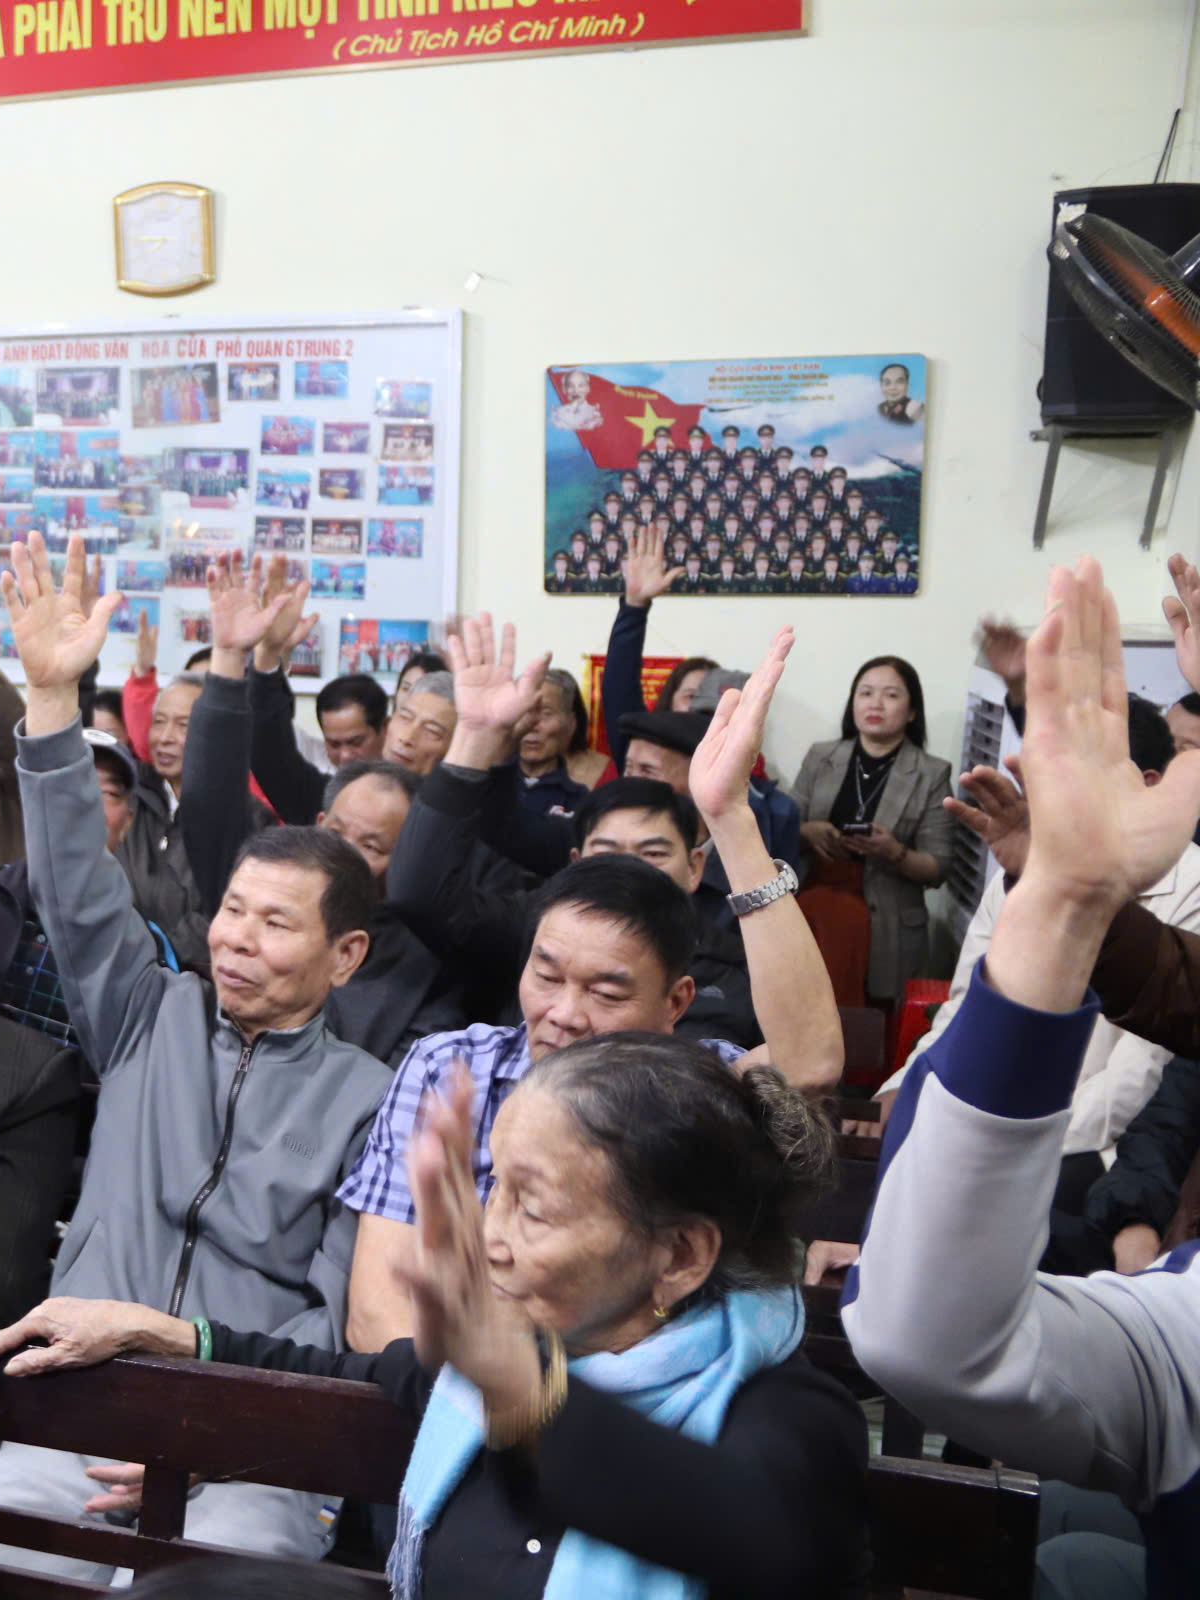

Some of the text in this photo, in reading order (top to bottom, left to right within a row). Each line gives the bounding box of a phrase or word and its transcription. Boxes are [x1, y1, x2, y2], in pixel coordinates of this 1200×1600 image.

[408, 28, 459, 56] Tịch
[509, 17, 559, 43] Chí
[560, 14, 626, 39] Minh
